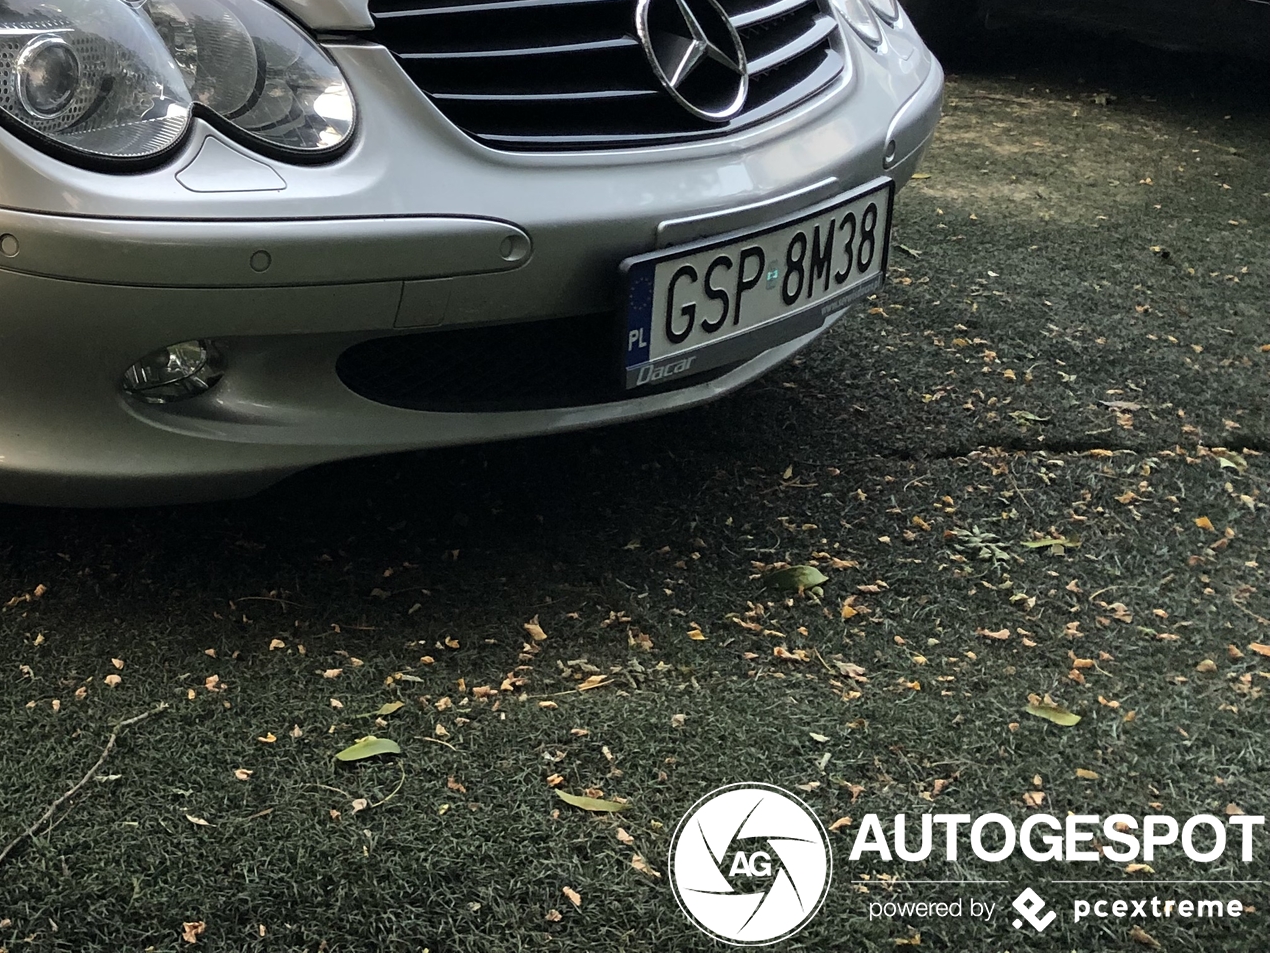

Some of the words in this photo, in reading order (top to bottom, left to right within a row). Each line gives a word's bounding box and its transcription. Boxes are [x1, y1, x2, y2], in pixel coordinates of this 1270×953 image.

[665, 245, 766, 344] GSP
[781, 202, 878, 305] 8M38
[627, 329, 648, 352] PL
[636, 356, 697, 387] Dacar
